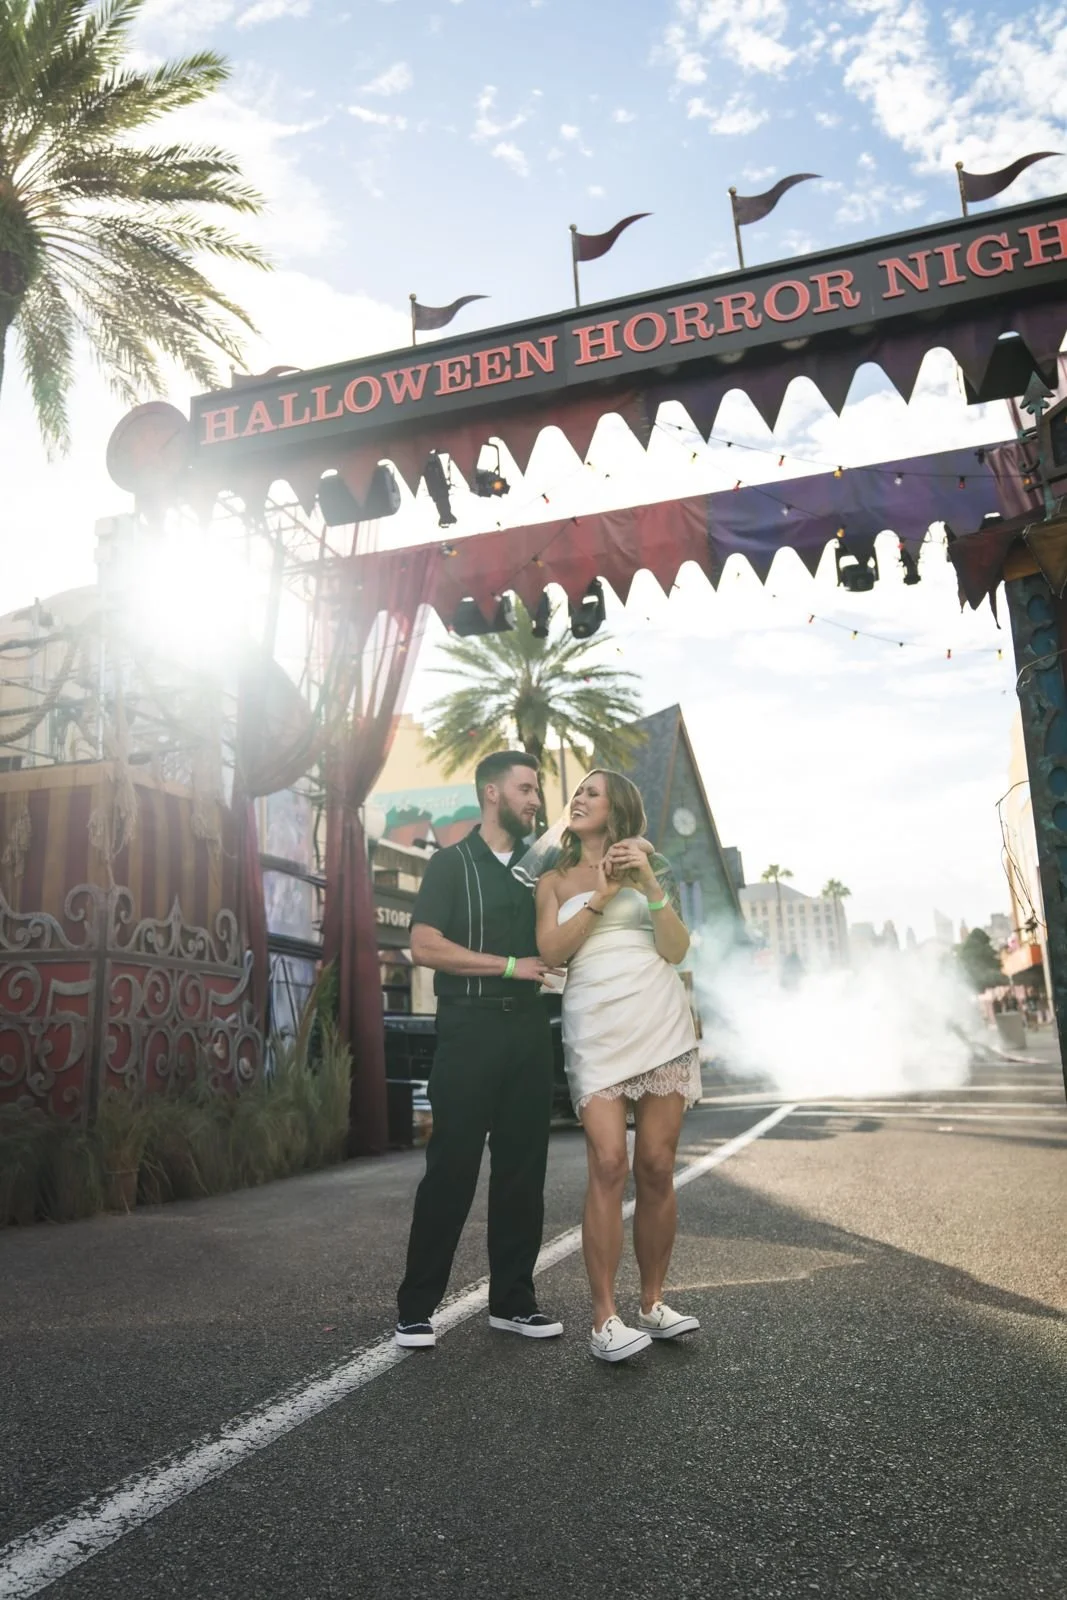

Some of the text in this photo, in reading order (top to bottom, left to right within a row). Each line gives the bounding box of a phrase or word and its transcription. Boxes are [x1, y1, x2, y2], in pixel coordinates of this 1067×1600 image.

[201, 217, 1067, 445] HALLOWEEN HORROR NIGH
